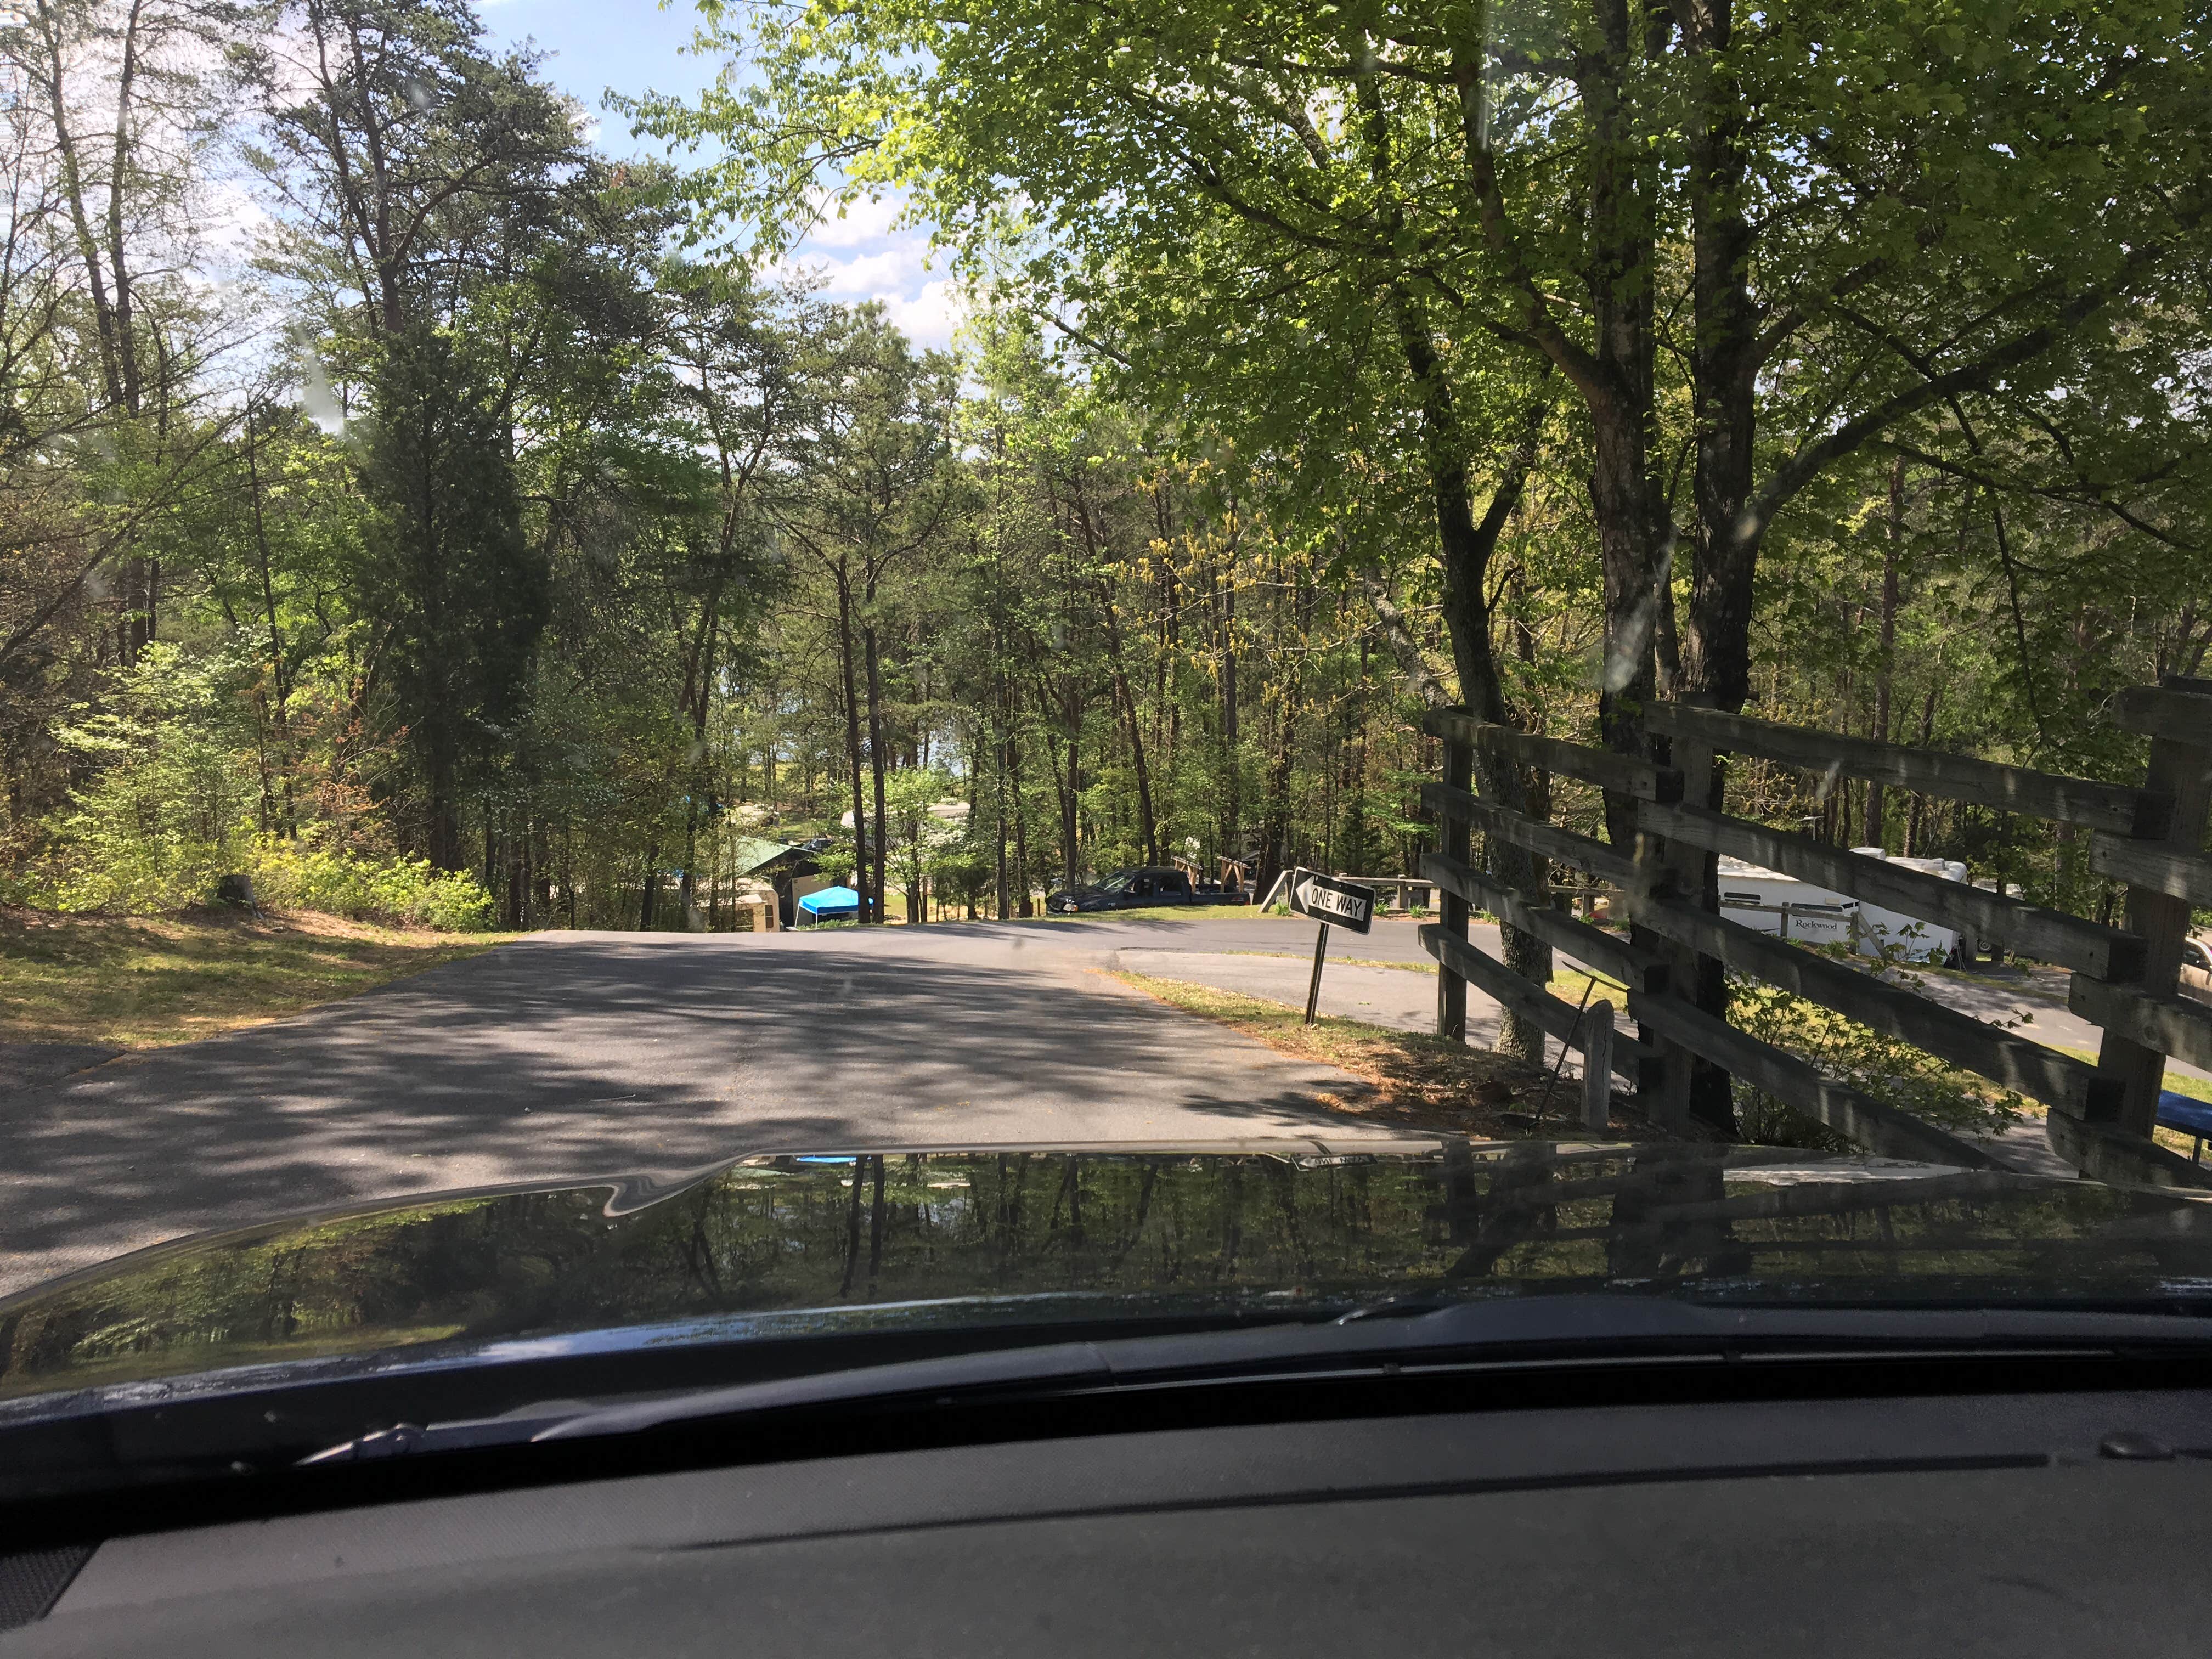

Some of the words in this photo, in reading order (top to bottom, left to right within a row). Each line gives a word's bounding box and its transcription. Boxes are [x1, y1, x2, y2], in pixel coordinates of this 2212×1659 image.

[1312, 888, 1333, 909] ONE
[1336, 895, 1363, 917] WAY
[1795, 919, 1837, 930] Rockwood
